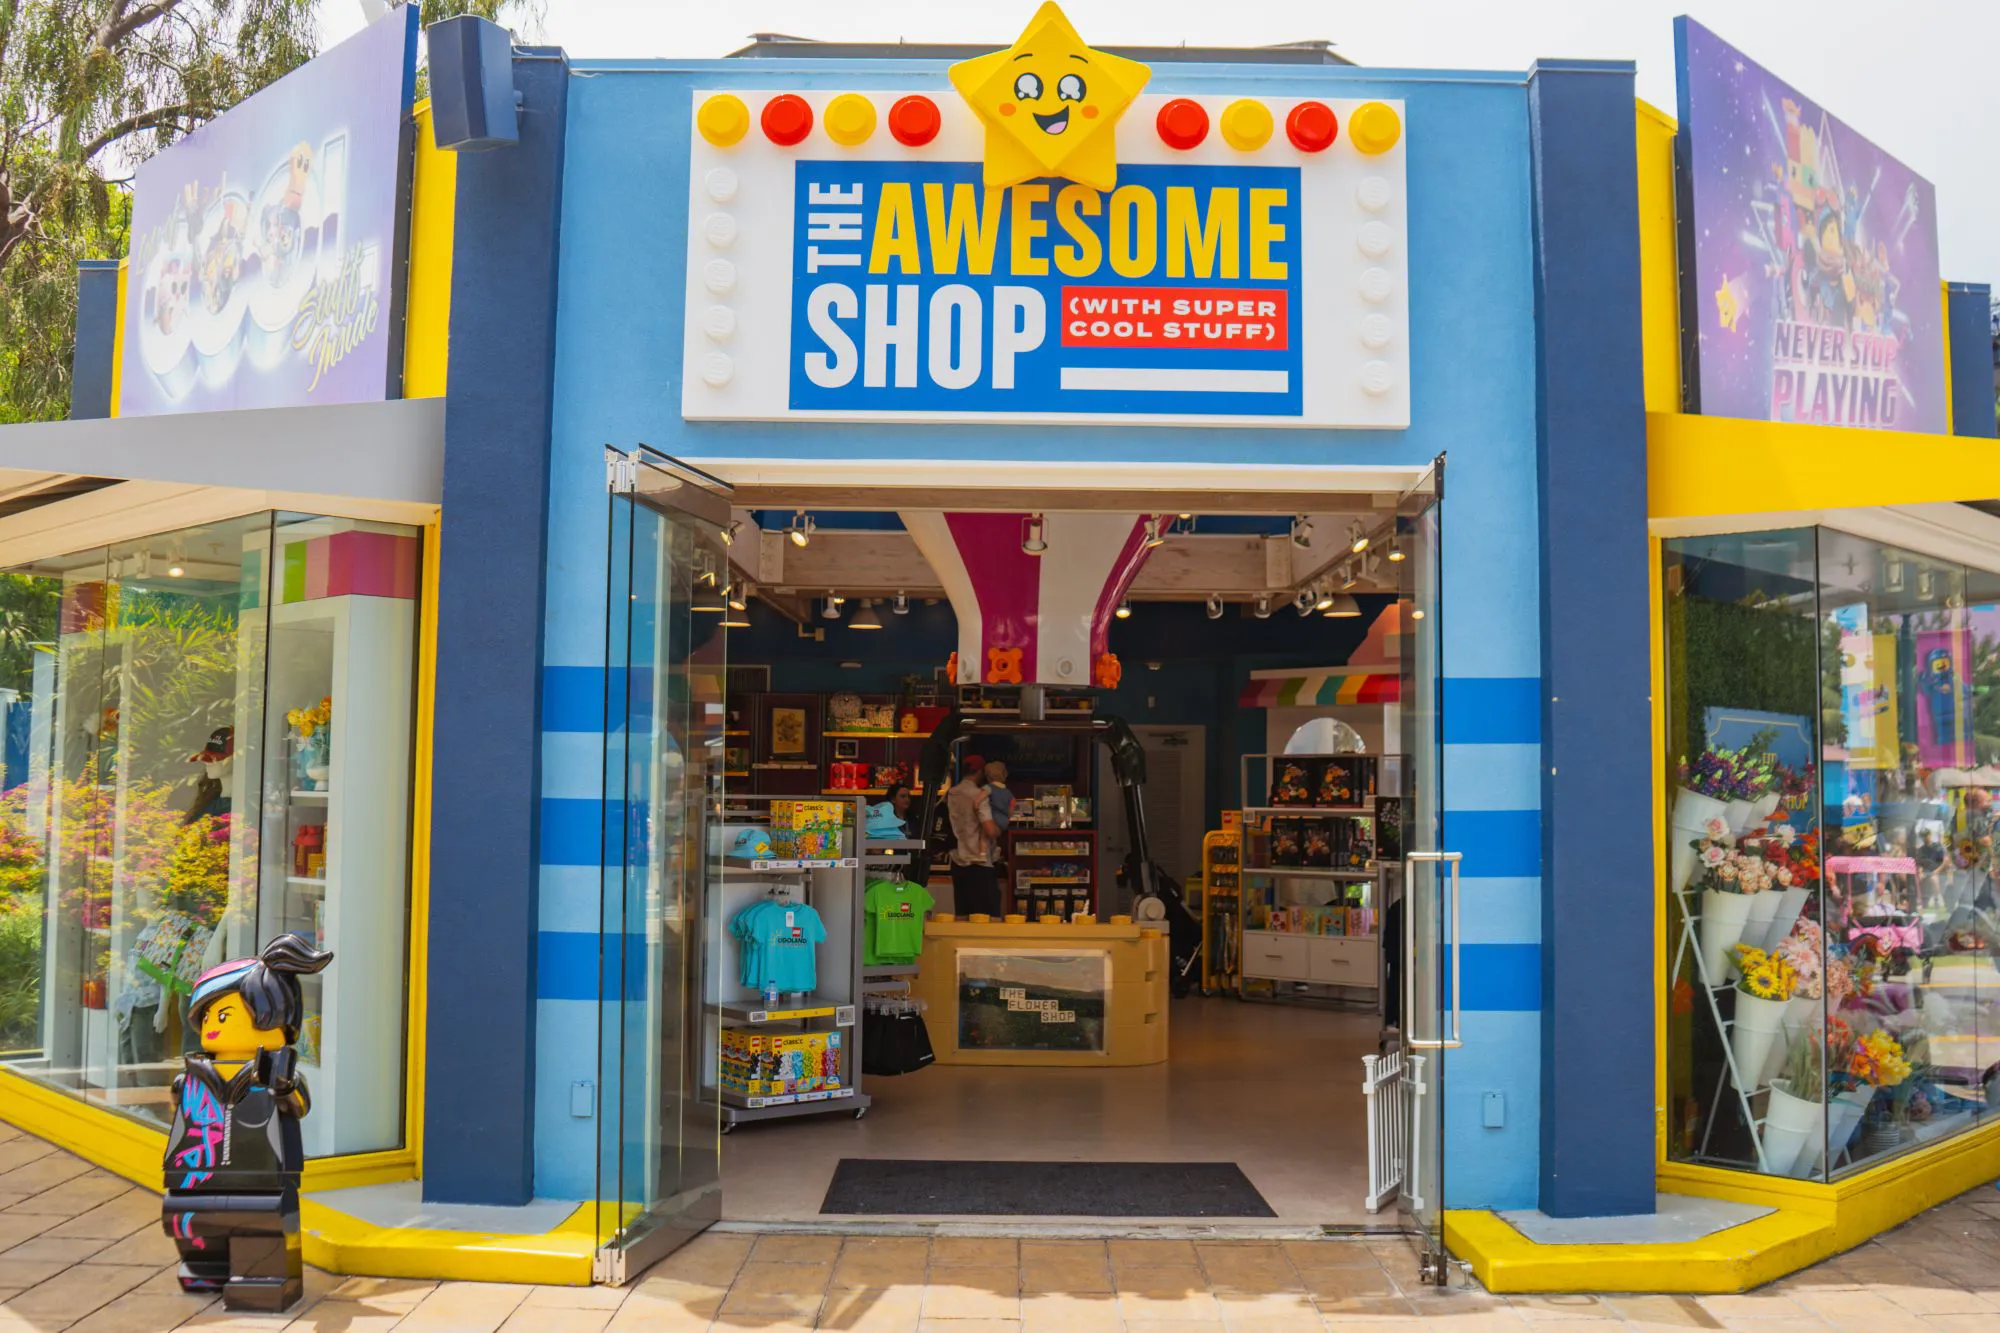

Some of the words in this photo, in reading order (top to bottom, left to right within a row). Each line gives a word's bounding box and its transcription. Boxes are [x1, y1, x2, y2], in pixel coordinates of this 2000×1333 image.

[807, 183, 863, 273] THE
[868, 182, 1288, 280] AWESOME
[291, 240, 363, 351] Stuff
[1069, 297, 1161, 316] (WITH
[1174, 299, 1276, 317] SUPER
[306, 286, 378, 392] Inside
[804, 283, 1046, 390] SHOP
[1069, 320, 1152, 338] COOL
[1163, 322, 1275, 341] STUFF)
[1774, 321, 1845, 364] NEVER
[1849, 332, 1898, 371] STOP
[1773, 368, 1898, 424] PLAYING
[1002, 989, 1025, 999] THE
[1008, 1000, 1057, 1010] FLOWER
[1042, 1012, 1074, 1022] SHOP
